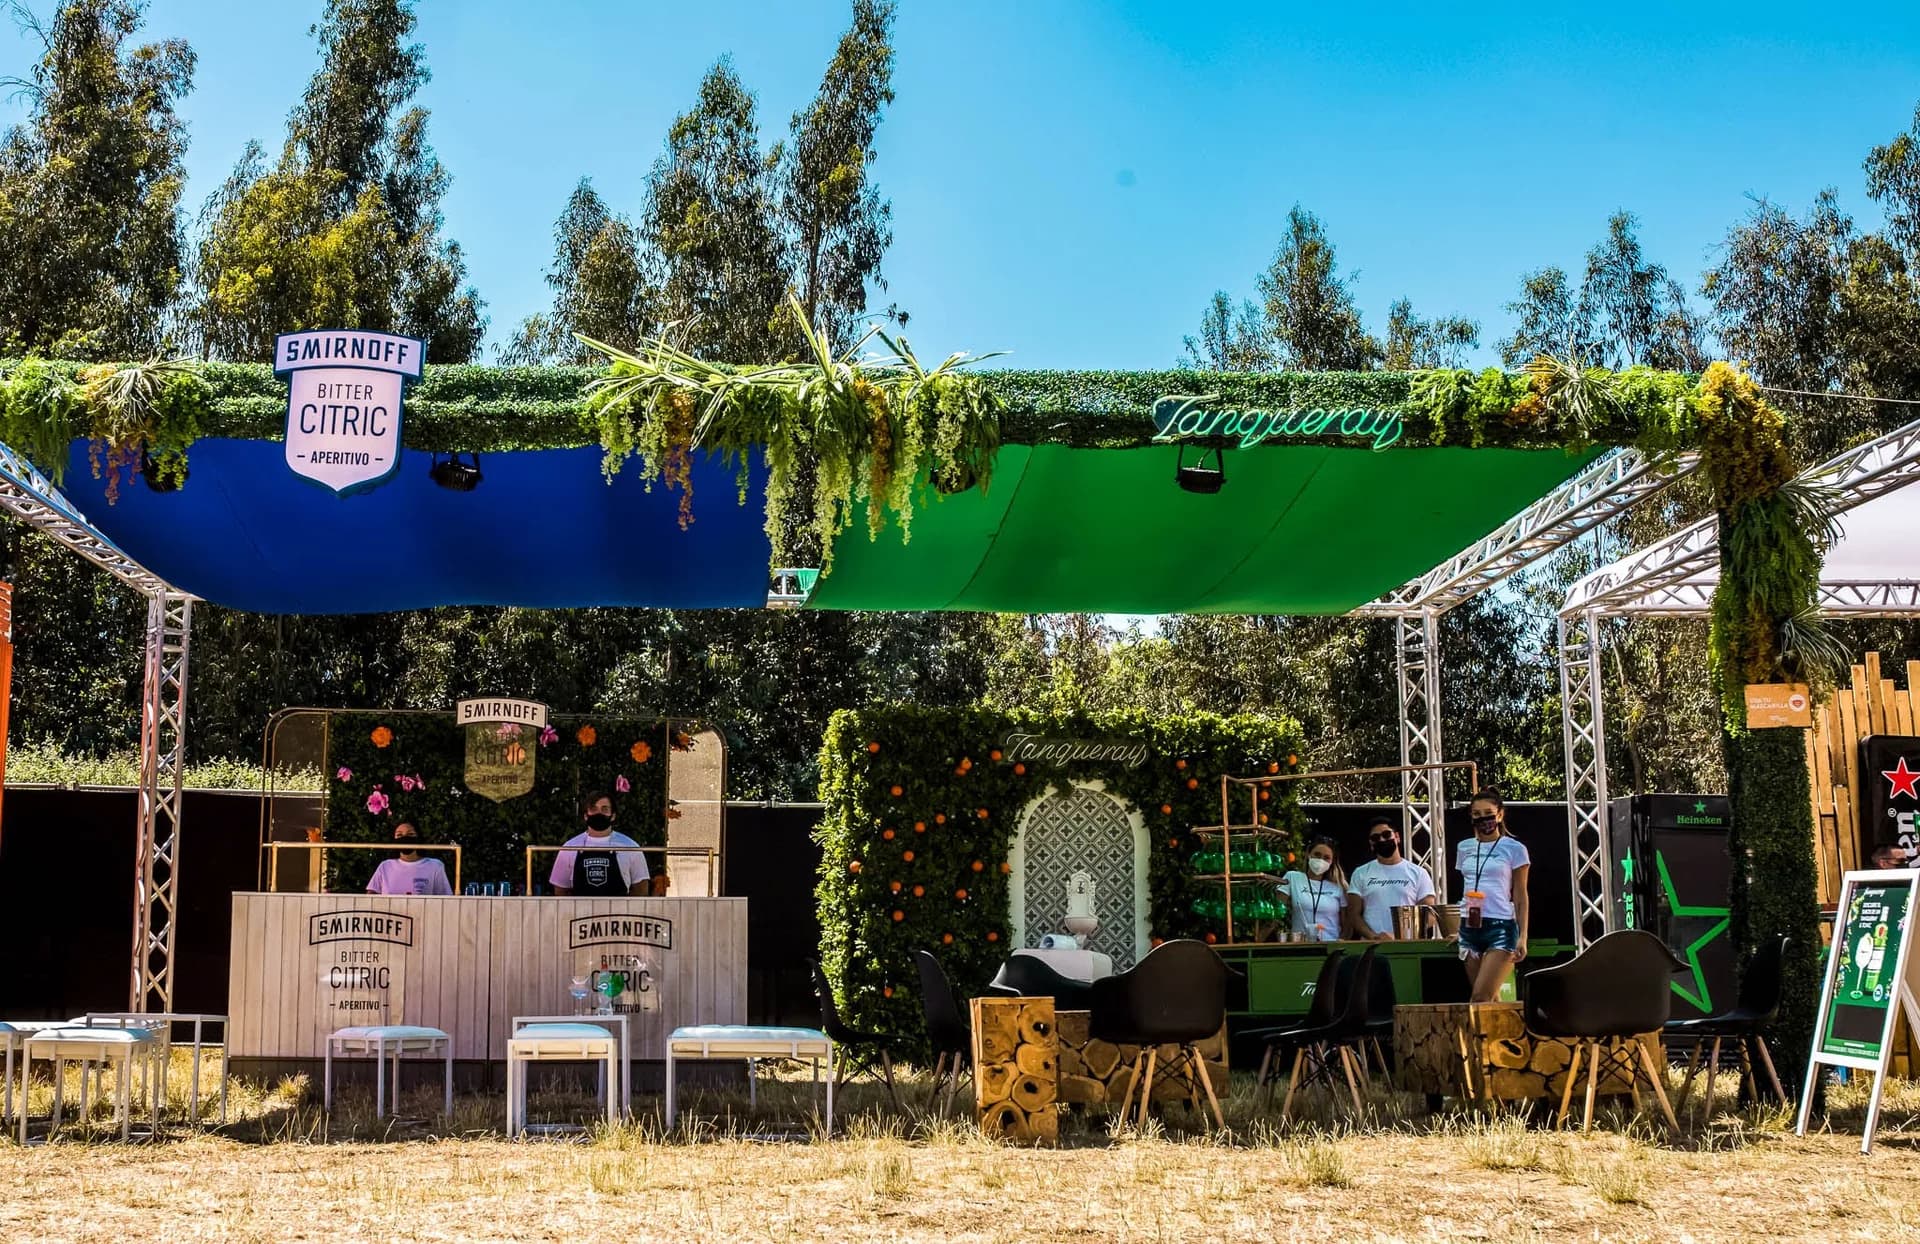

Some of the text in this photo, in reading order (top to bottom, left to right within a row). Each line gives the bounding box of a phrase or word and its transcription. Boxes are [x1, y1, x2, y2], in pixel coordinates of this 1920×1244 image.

[286, 337, 409, 364] SMIRNOFF
[318, 383, 373, 400] BITTER
[300, 404, 387, 436] CITRIC
[1152, 393, 1403, 451] Tanqueray
[311, 451, 370, 466] APERITIVO
[464, 703, 538, 720] SMIRNOFF
[1006, 733, 1147, 767] Tanqueray
[1677, 815, 1722, 825] Heineken
[319, 917, 402, 936] SMIRNOFF
[579, 921, 661, 939] SMIRNOFF
[341, 951, 380, 963] BITTER
[601, 954, 640, 967] BITTER
[330, 966, 390, 989] CITRIC
[339, 1001, 380, 1010] APERITIVO
